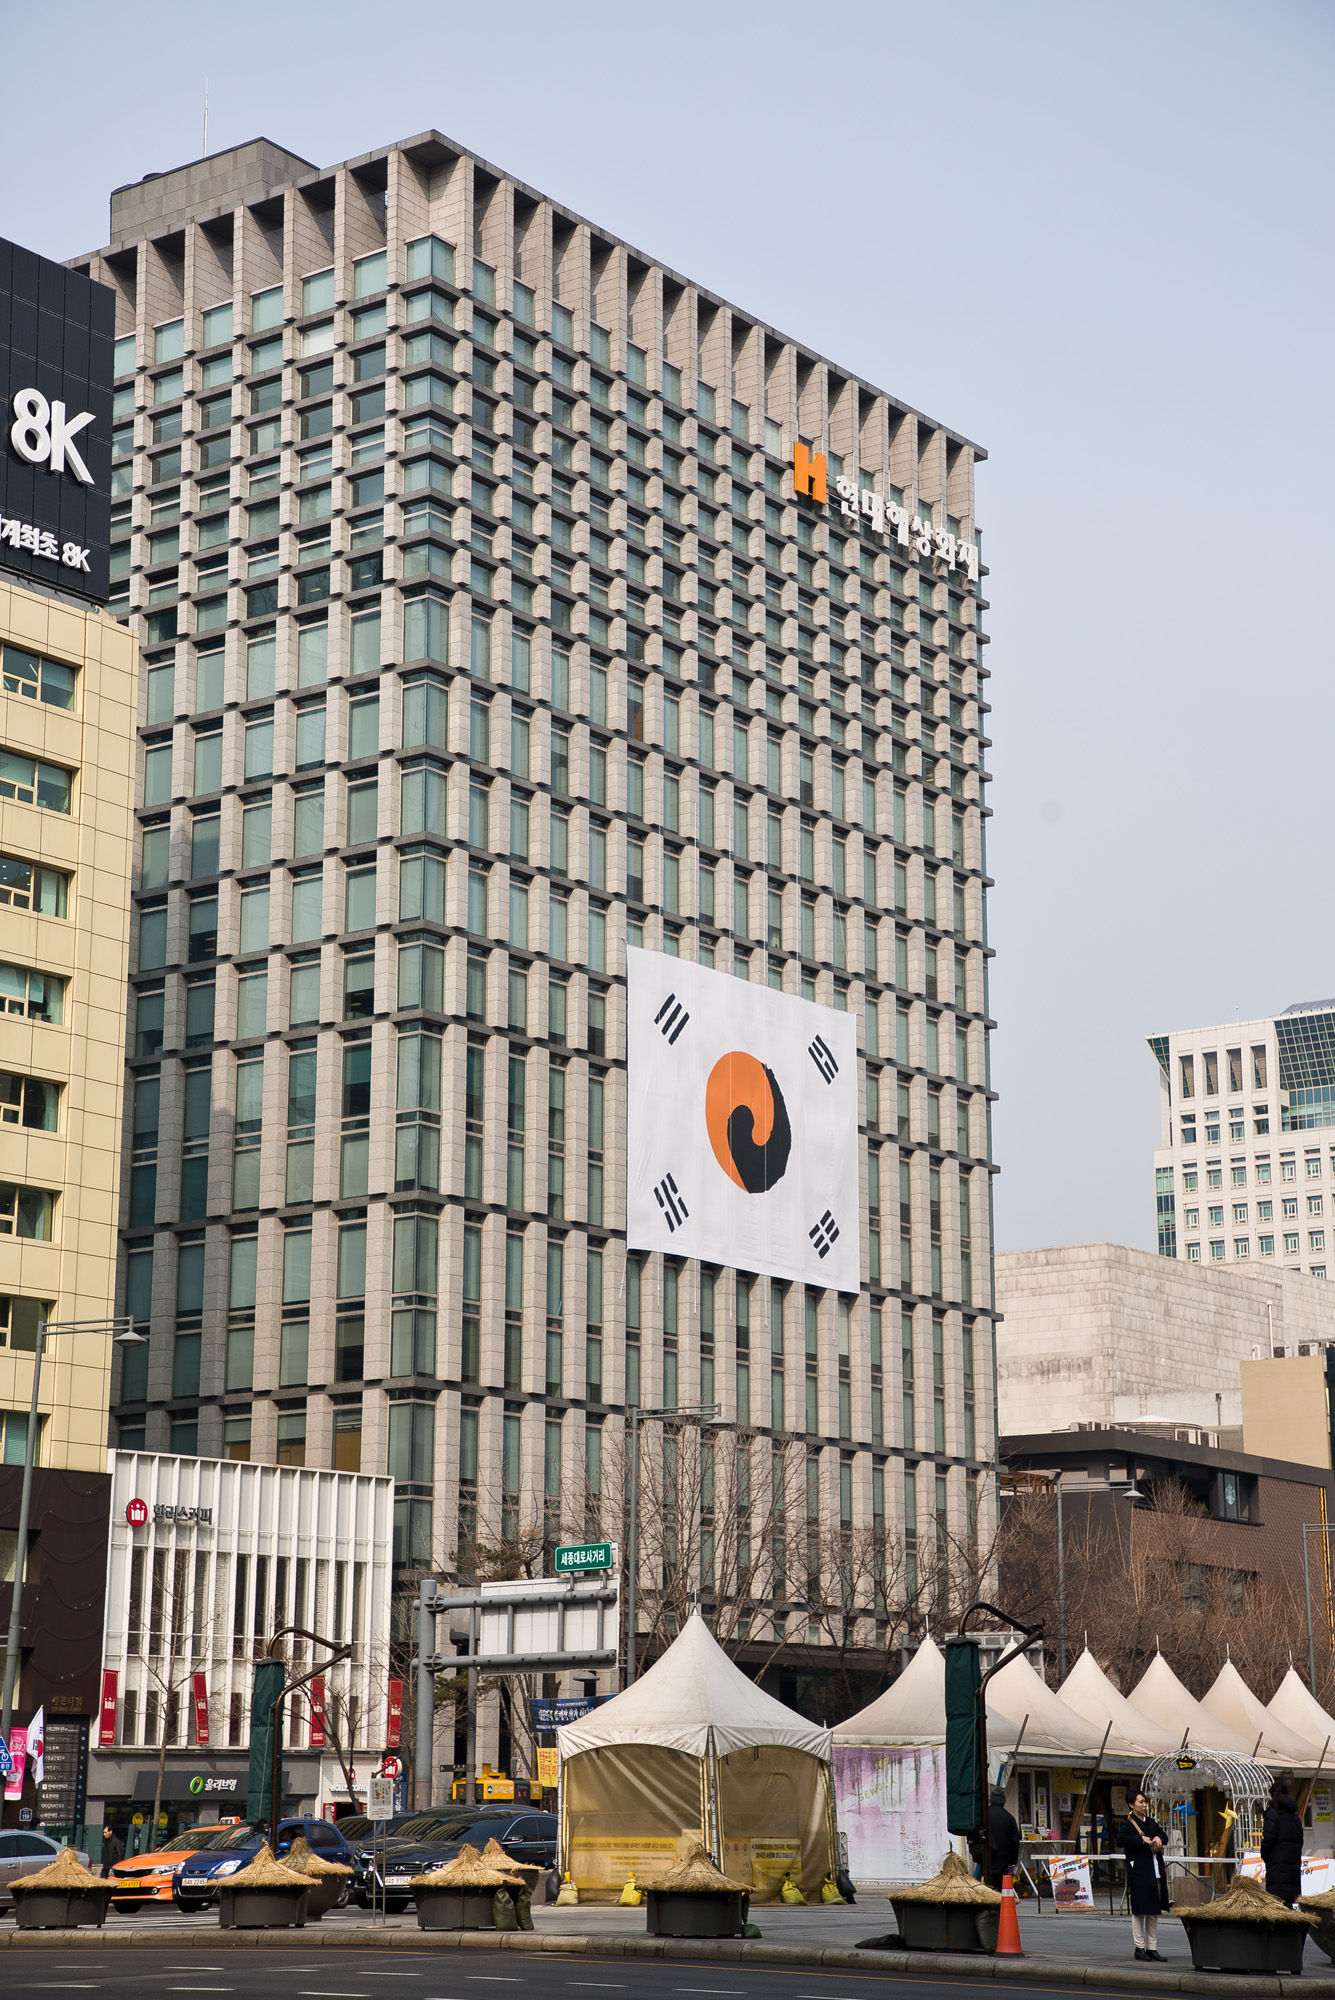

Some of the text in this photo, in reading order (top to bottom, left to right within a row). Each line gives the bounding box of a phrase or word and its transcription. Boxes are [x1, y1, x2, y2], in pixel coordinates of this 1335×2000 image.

[11, 388, 96, 485] 8K
[0, 513, 91, 572] 계최초 8K
[836, 475, 979, 583] 현대해상화재
[153, 1504, 212, 1526] 할리스커피
[561, 1548, 605, 1566] 세종대로사거리
[205, 1778, 238, 1791] 올리브영
